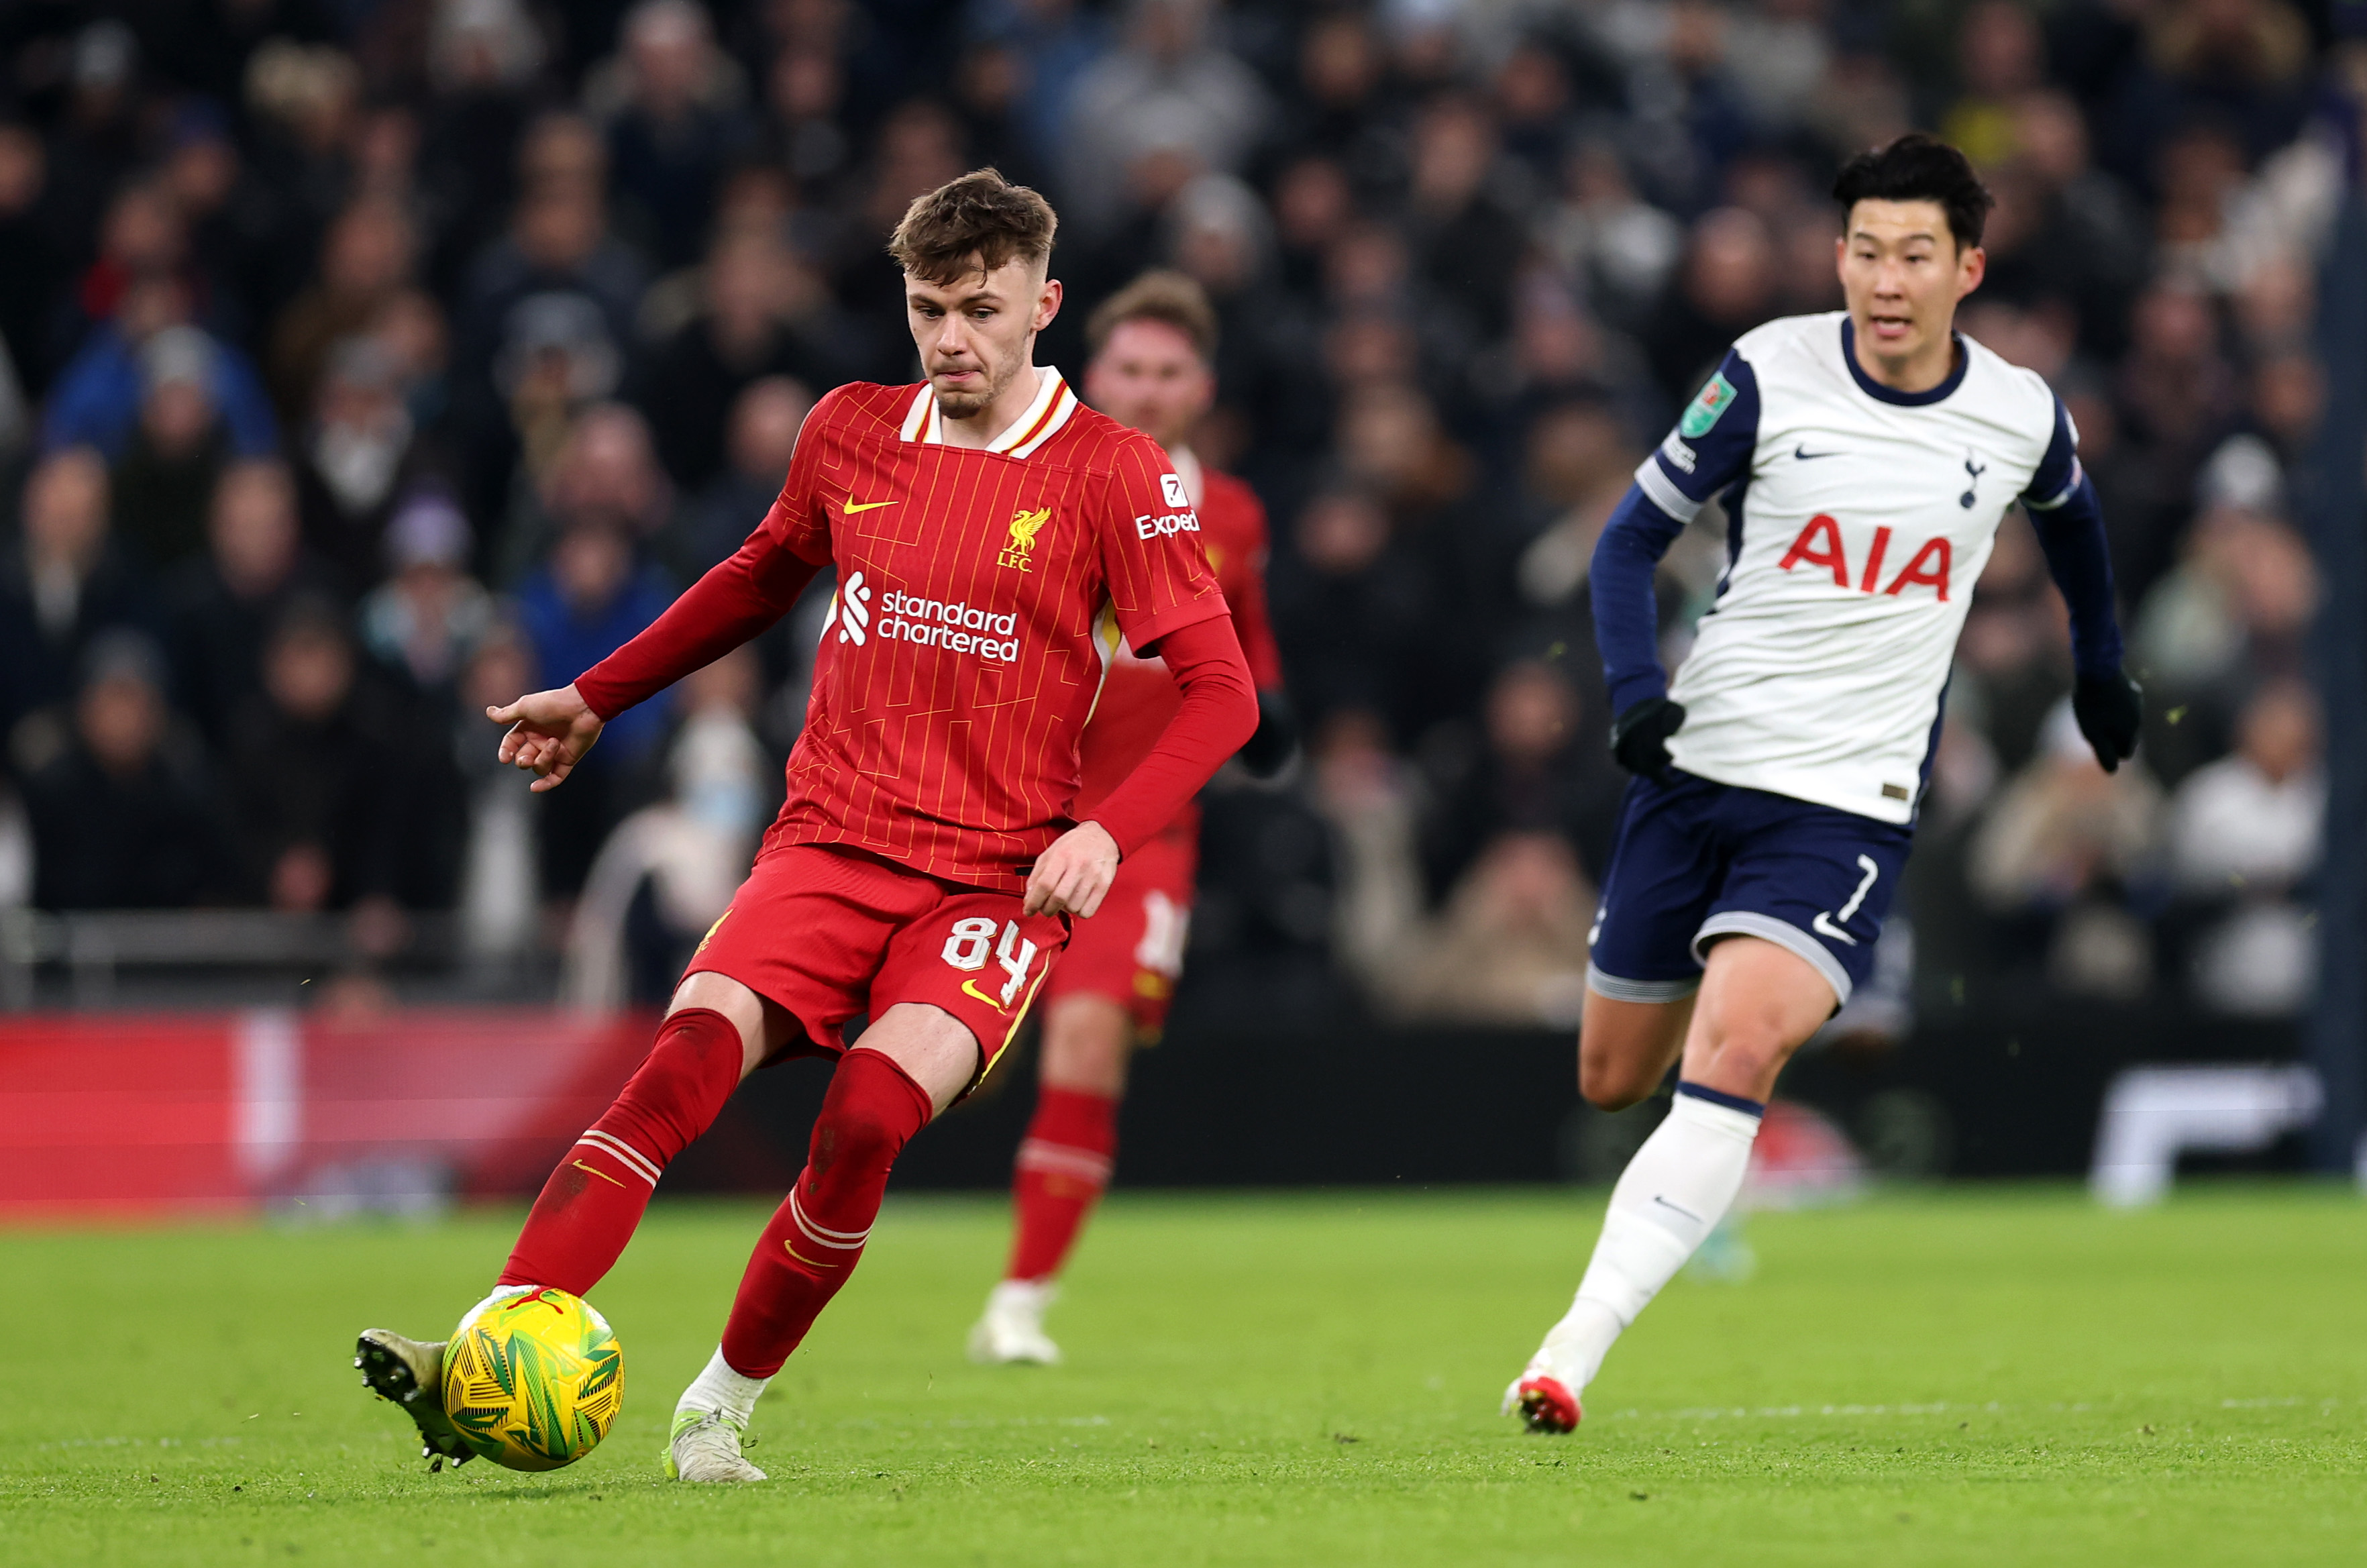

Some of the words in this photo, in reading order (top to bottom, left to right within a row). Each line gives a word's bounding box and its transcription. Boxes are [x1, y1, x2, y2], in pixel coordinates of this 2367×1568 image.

[1778, 513, 1951, 602] AIA
[878, 615, 1019, 662] chartered
[881, 590, 1017, 635] standard
[1837, 853, 1878, 923] 7
[941, 917, 1038, 1008] 84
